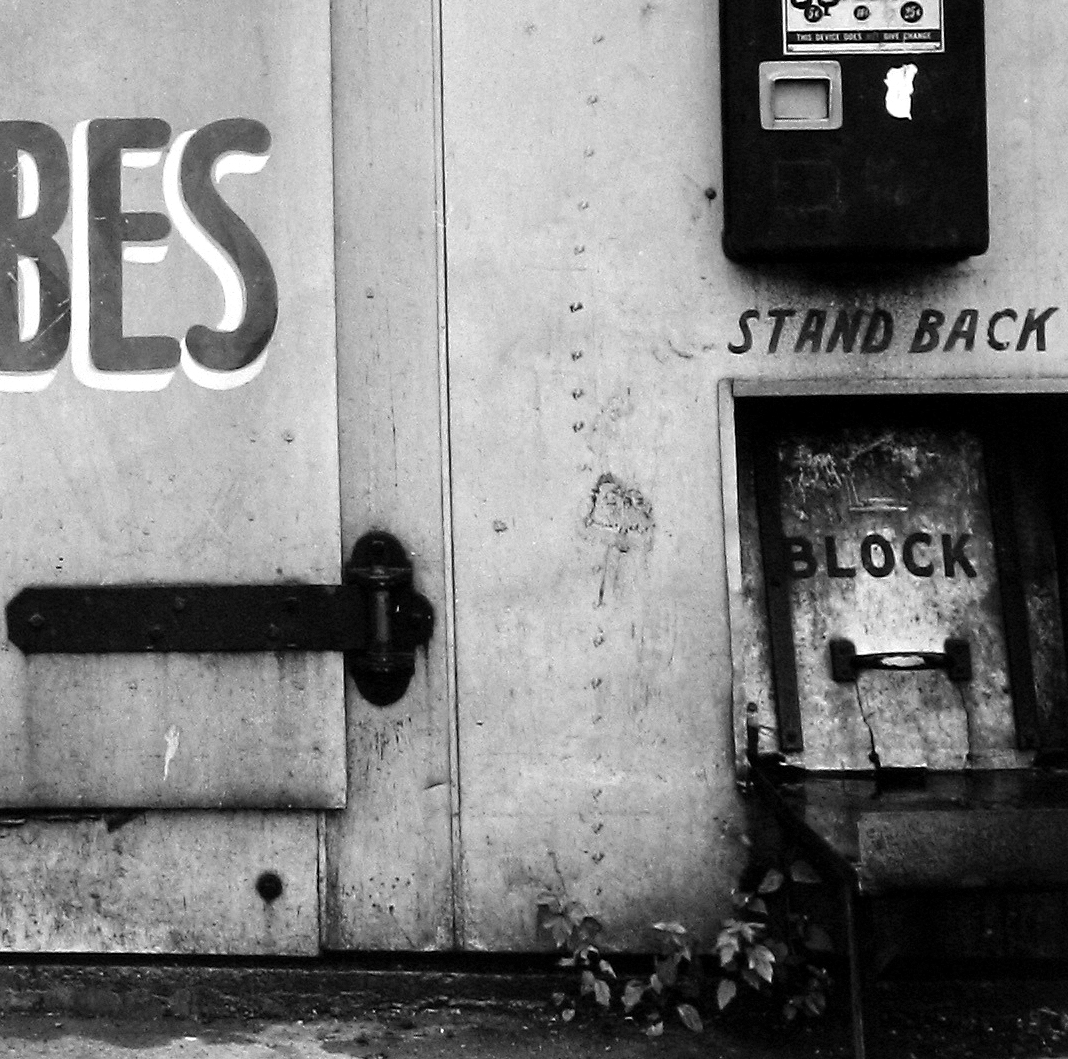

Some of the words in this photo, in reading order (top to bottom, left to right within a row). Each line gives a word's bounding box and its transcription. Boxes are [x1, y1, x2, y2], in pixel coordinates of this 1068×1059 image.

[728, 307, 894, 354] STAND
[909, 307, 1058, 352] BACK
[784, 532, 977, 578] BLOCK
